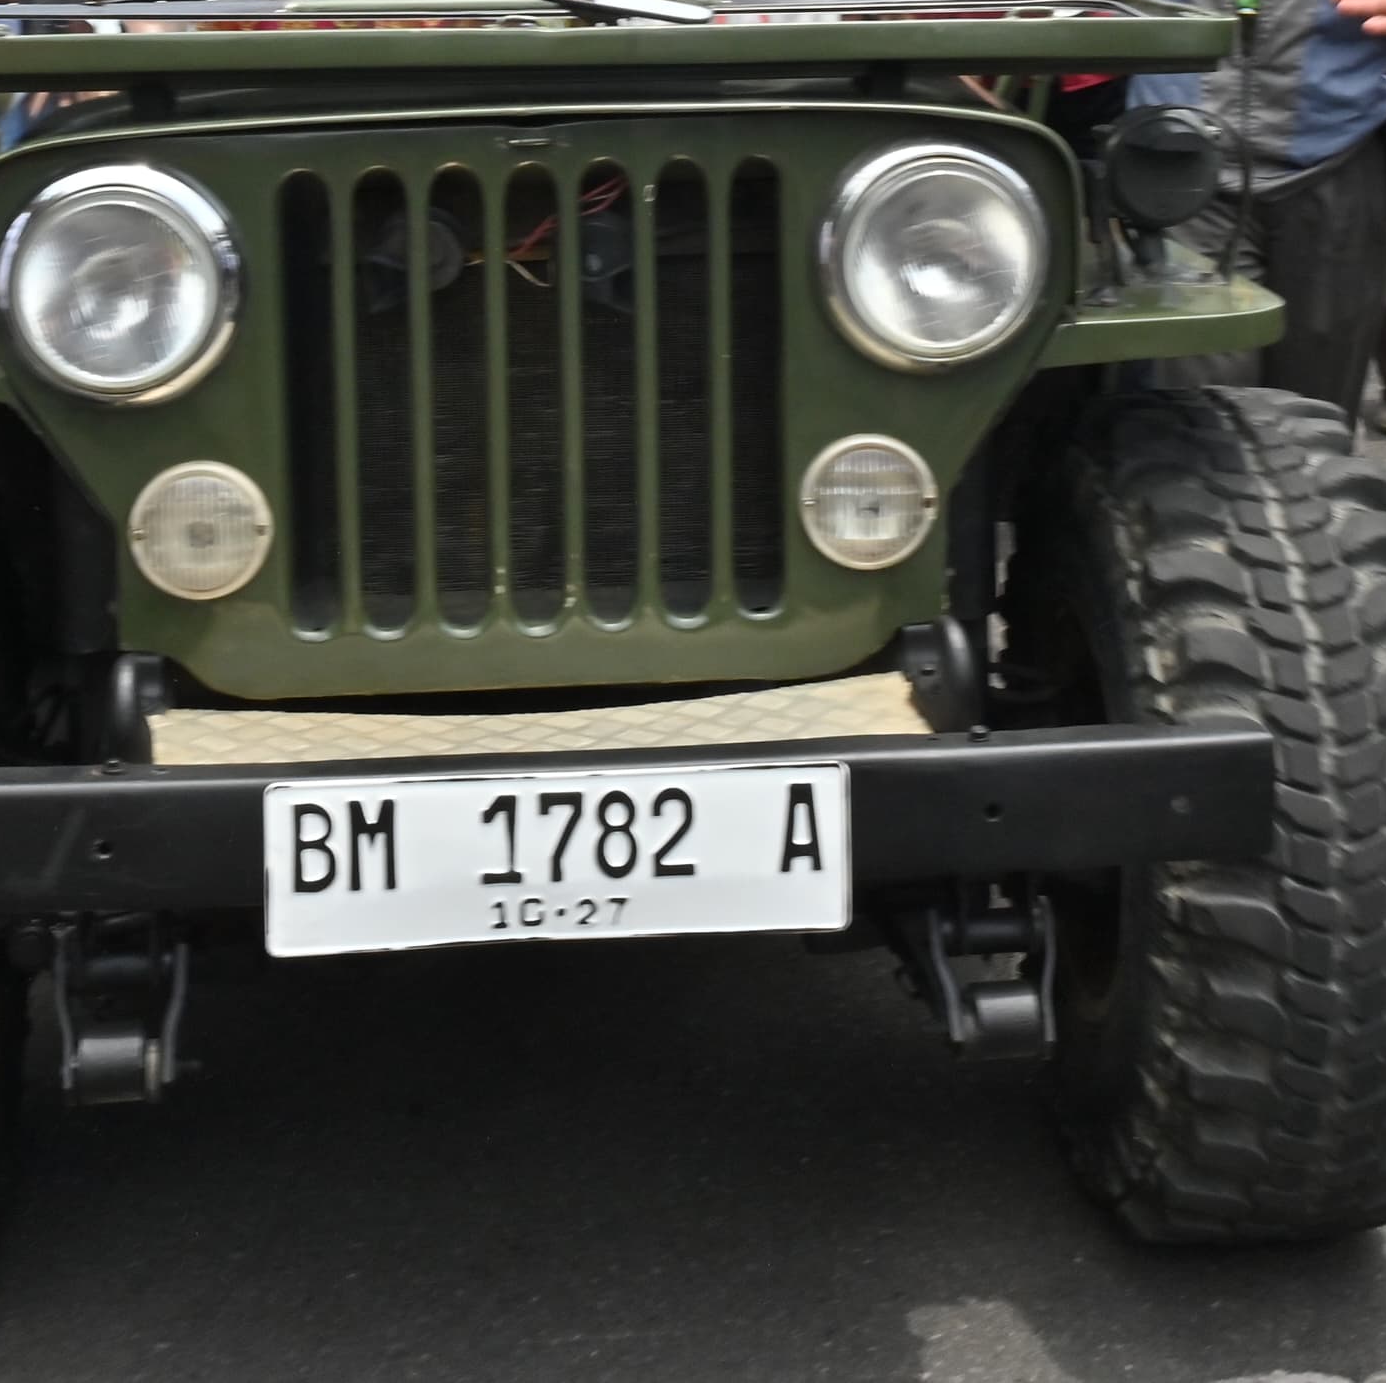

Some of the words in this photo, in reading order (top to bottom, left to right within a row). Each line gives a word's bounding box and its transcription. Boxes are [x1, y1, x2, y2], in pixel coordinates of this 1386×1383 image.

[292, 799, 396, 894] BM
[479, 786, 698, 885] 1782
[779, 783, 823, 874] A
